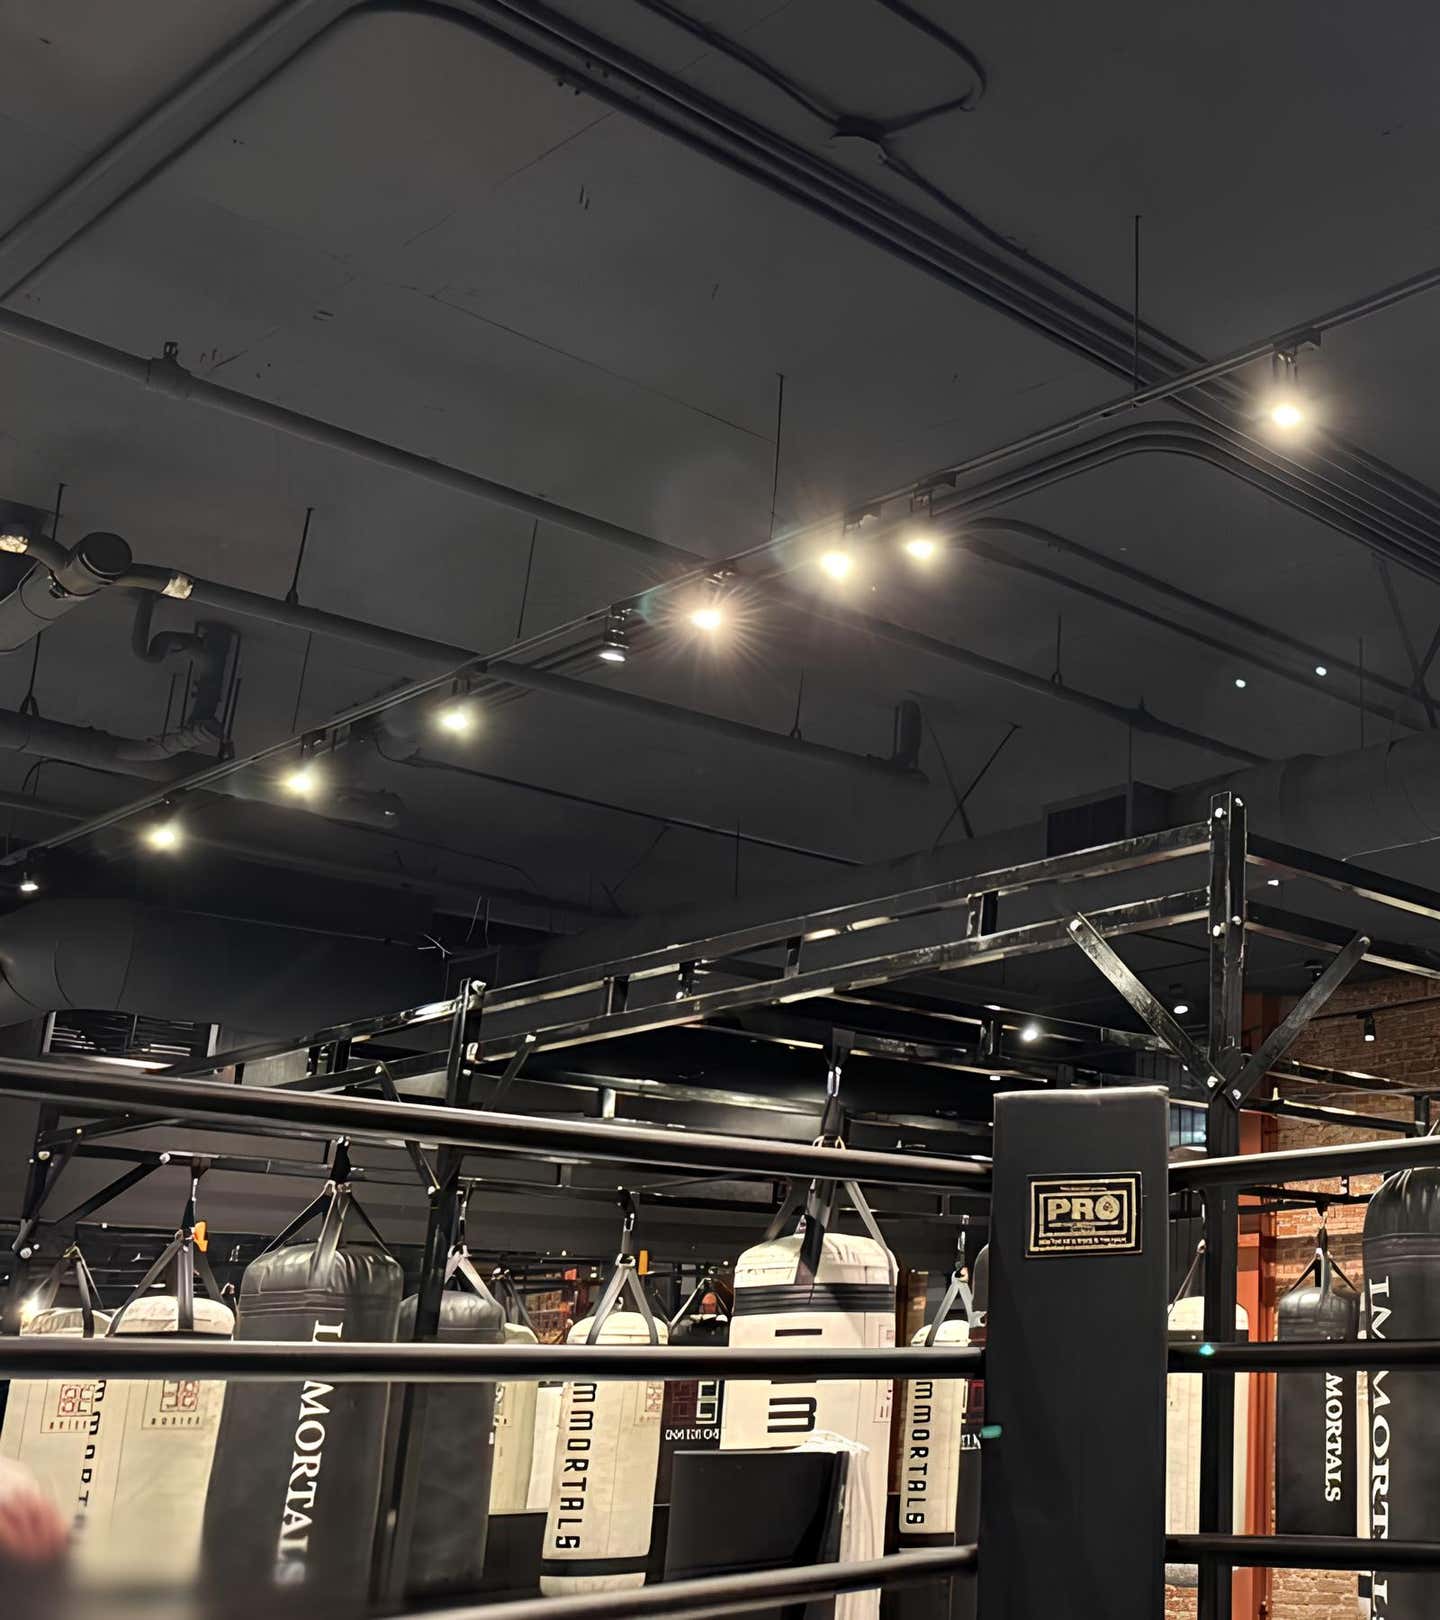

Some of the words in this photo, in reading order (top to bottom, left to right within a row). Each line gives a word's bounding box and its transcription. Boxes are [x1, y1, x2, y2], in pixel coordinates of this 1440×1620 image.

[1047, 1195, 1121, 1221] PRO
[273, 1319, 344, 1585] IMORTALS
[554, 1381, 599, 1549] MMORTALS
[905, 1380, 934, 1525] MMORTALS
[1324, 1372, 1344, 1502] MORTALS
